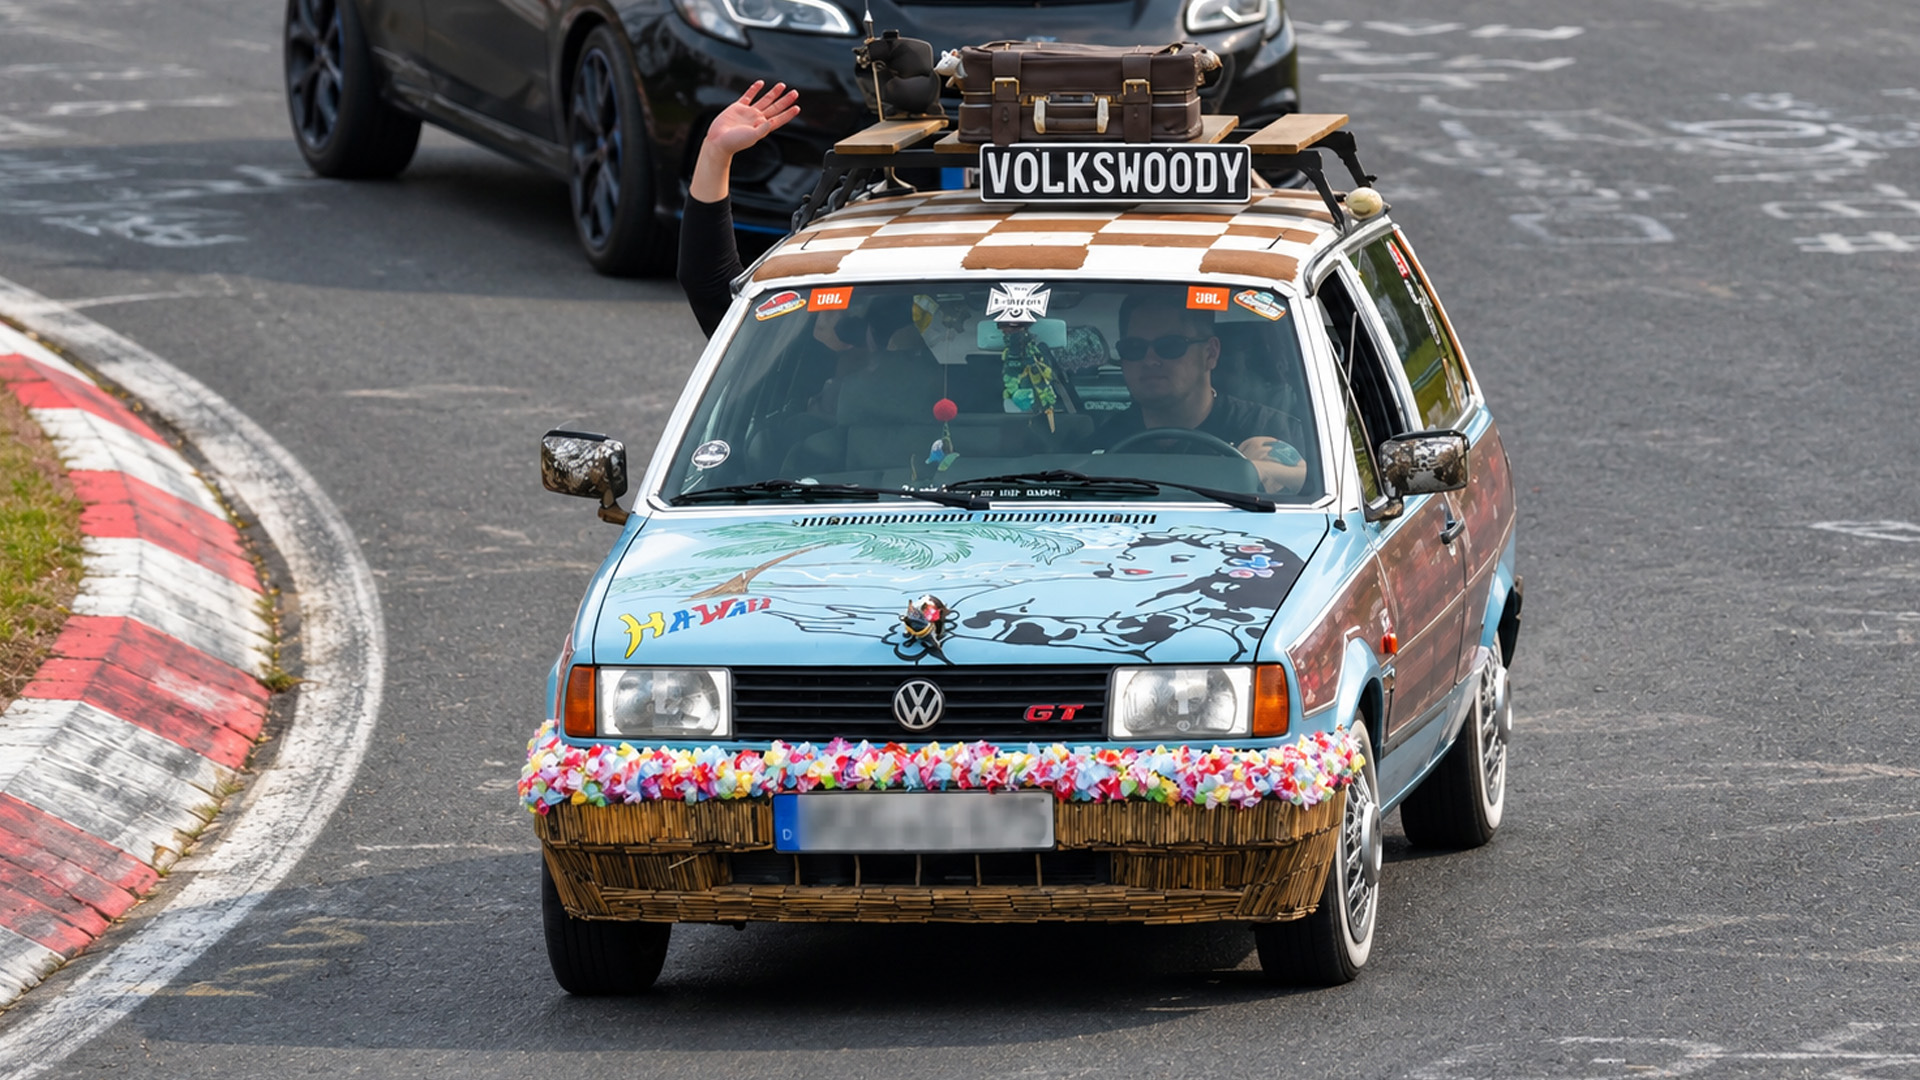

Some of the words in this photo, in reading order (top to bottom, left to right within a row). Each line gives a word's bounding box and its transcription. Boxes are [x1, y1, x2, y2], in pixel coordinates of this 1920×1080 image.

[987, 151, 1244, 194] VOLKSWOODY
[1195, 292, 1221, 305] JBL
[1023, 704, 1085, 722] GT
[782, 828, 792, 840] D
